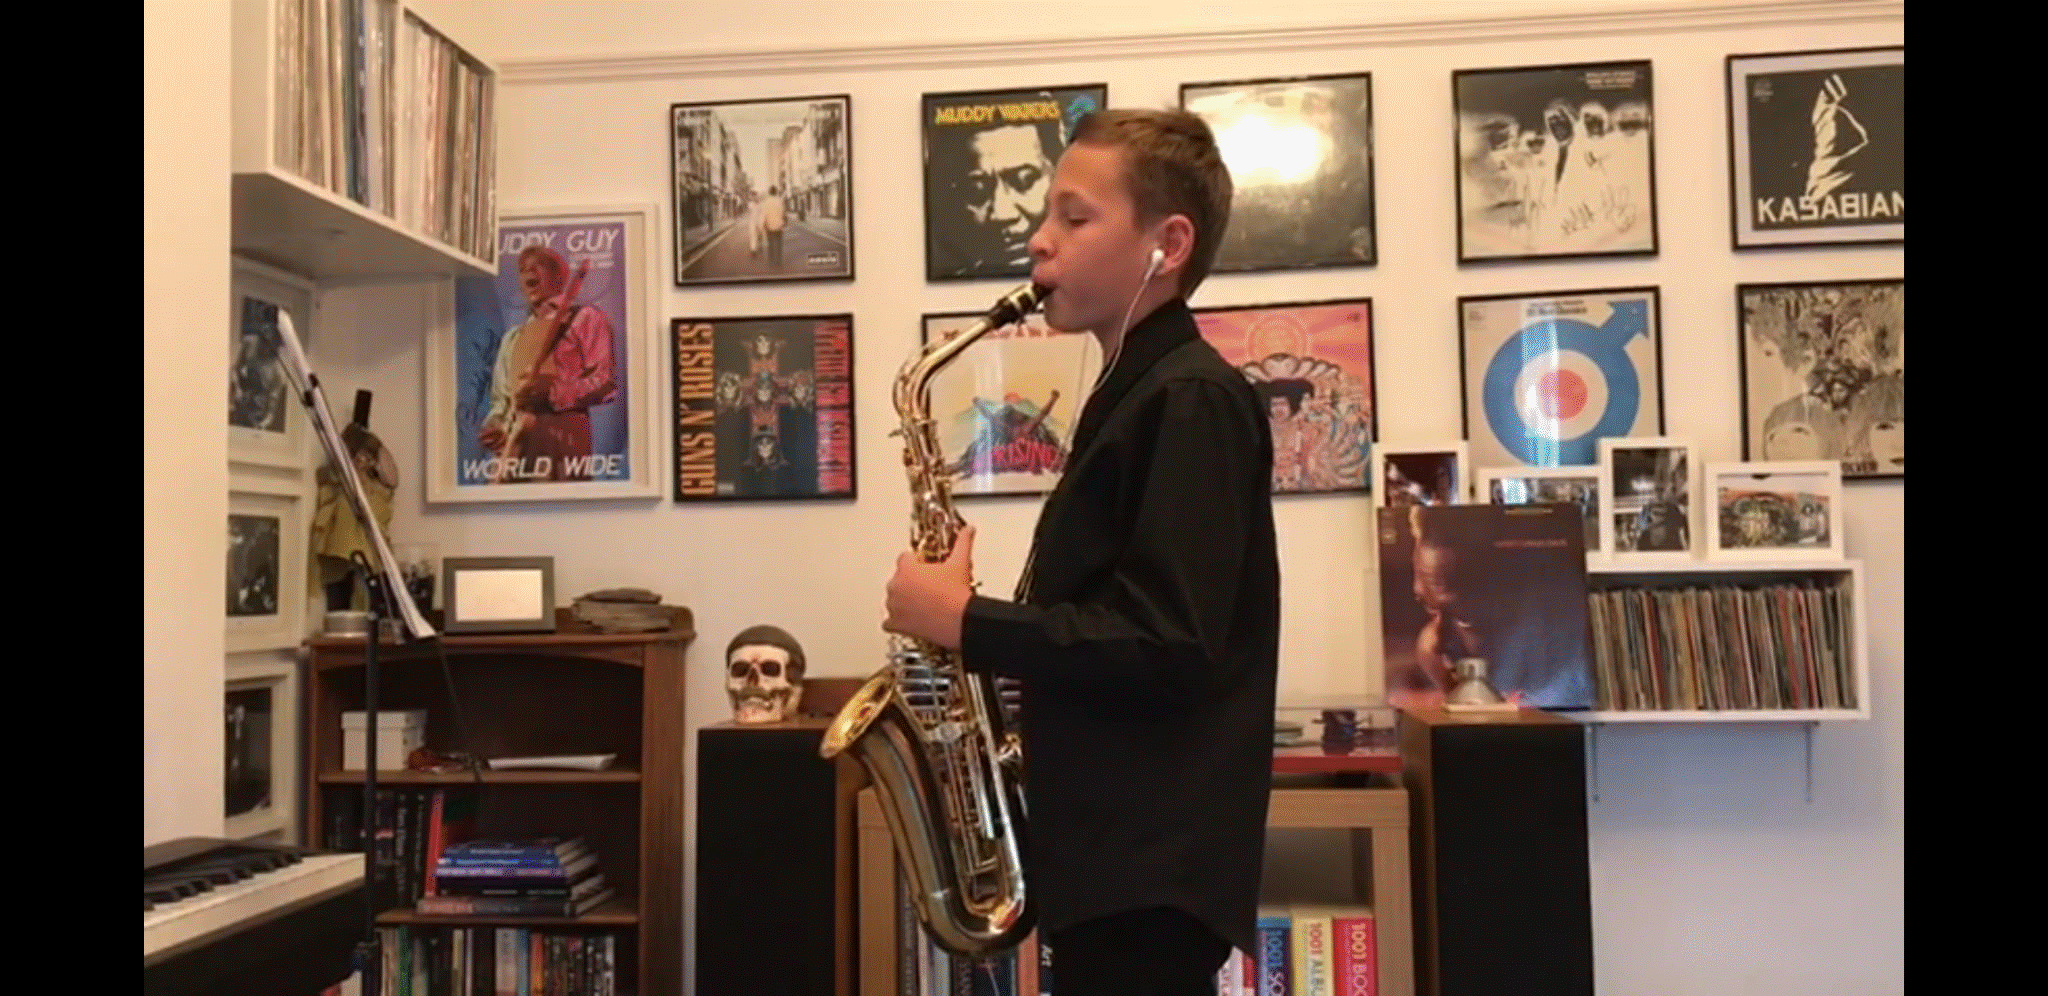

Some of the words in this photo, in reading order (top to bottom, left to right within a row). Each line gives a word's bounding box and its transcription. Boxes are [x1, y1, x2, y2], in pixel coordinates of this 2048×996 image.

[935, 106, 994, 125] MUDDY
[1757, 191, 1904, 224] KASABIAN
[498, 231, 557, 254] UDDY
[566, 229, 619, 252] GUY
[678, 323, 714, 400] ROSES
[463, 456, 552, 479] WORLD
[563, 454, 625, 476] WIDE
[680, 431, 716, 495] GUNS
[1267, 930, 1283, 968] 1001
[1309, 922, 1323, 955] 1001
[1351, 923, 1367, 960] 1001
